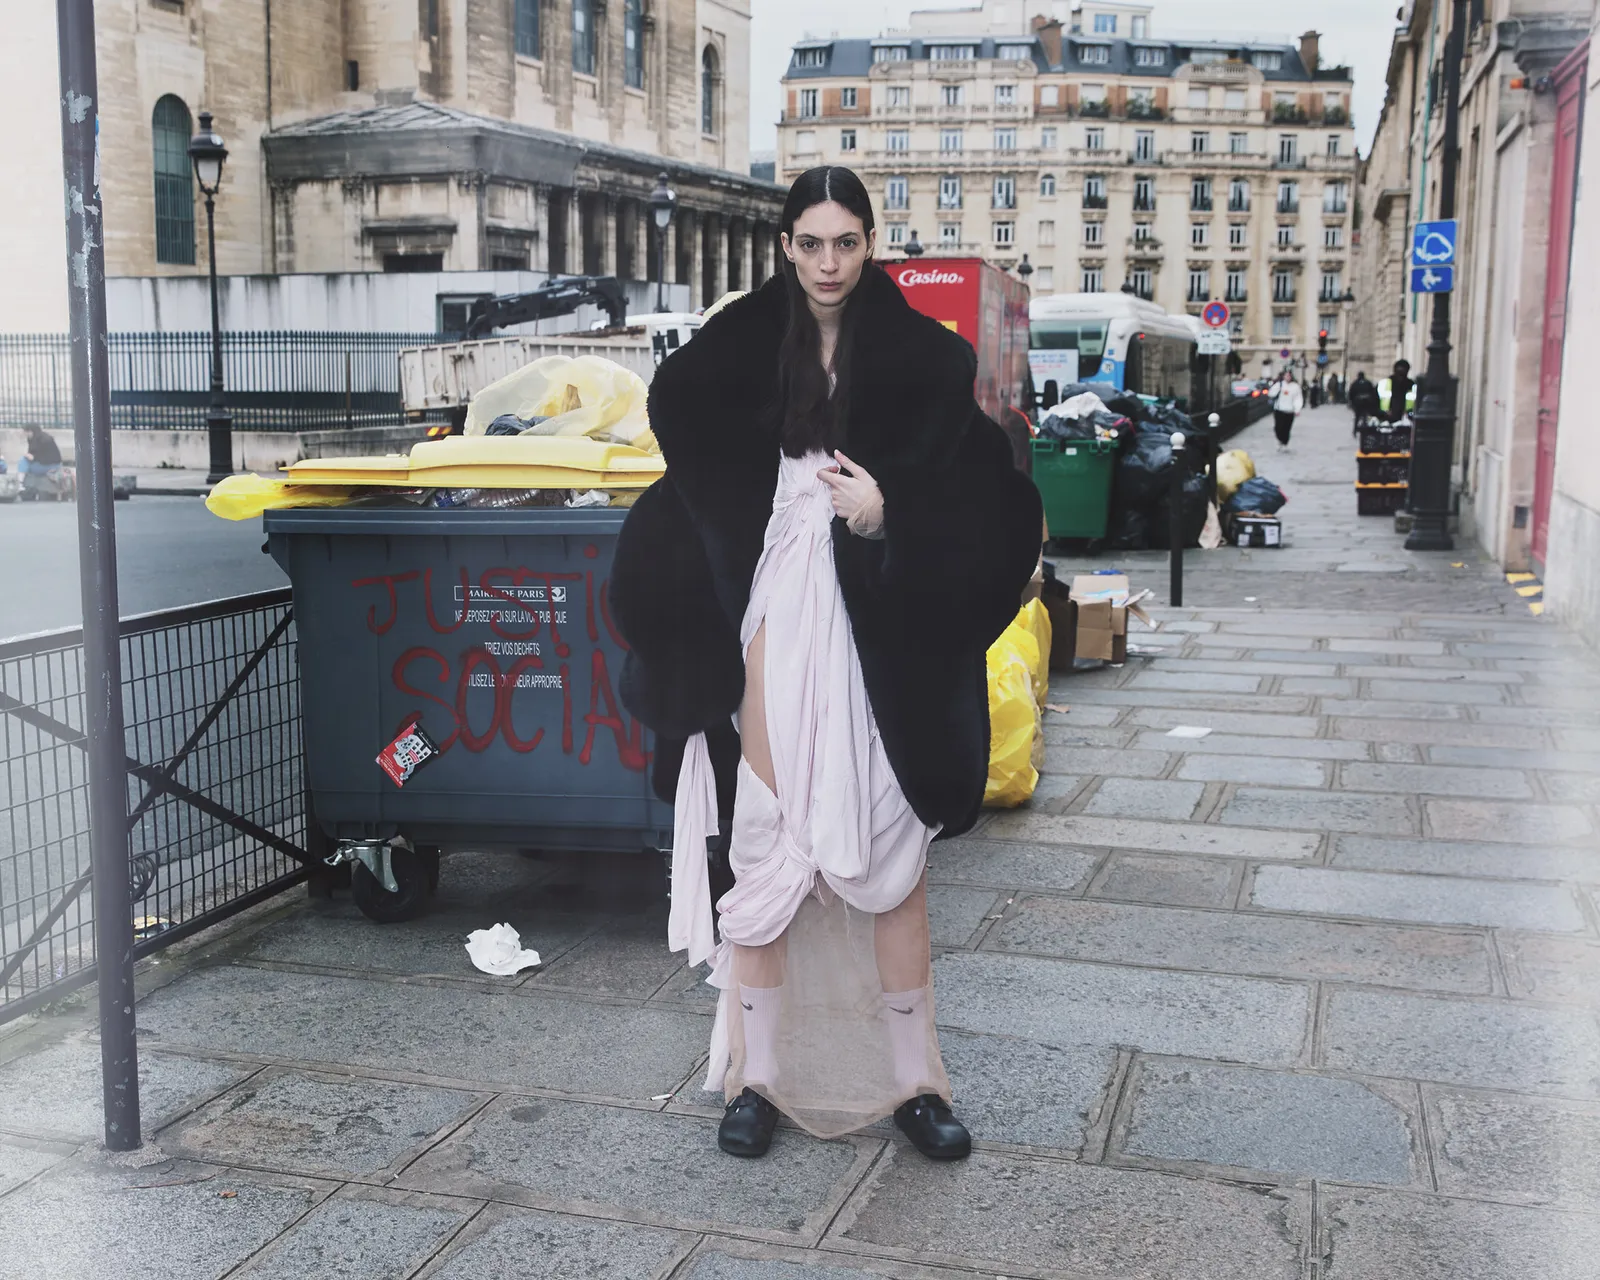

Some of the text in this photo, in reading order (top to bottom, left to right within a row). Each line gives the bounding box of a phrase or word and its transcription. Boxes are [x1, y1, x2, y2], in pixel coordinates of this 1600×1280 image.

[467, 590, 498, 598] MAIR
[517, 590, 544, 598] PARIS
[504, 611, 517, 623] SUR
[518, 611, 525, 623] LA
[539, 611, 567, 624] PUBQUE
[484, 642, 540, 656] TRIEZ VOS DECHETS
[466, 674, 487, 687] TILISEZ
[530, 675, 562, 689] APPROPRIE
